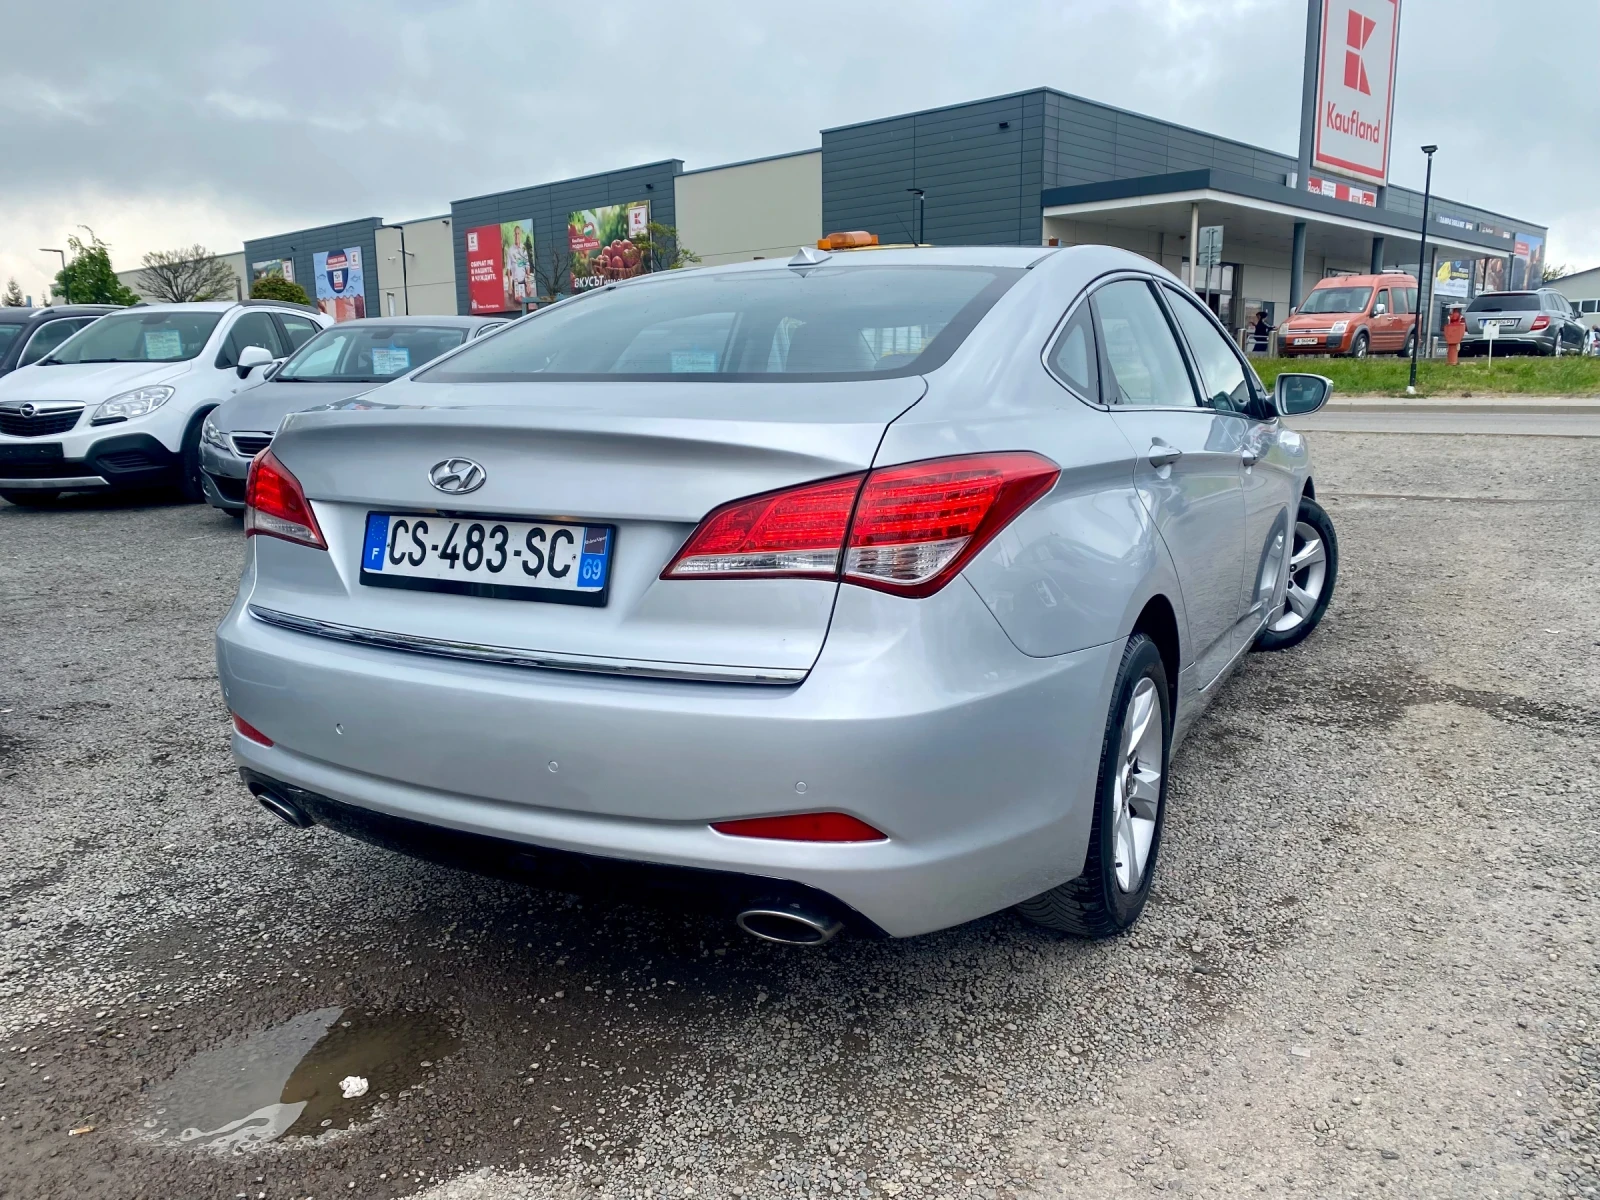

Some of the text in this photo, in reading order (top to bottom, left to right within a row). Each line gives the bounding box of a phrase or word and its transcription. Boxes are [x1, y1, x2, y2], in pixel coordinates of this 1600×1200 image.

[1326, 101, 1381, 144] Kaufland
[470, 259, 487, 268] ОБИЧАТ
[574, 275, 604, 288] ВКУСЪТ
[371, 547, 380, 561] F
[389, 519, 575, 579] CS-483-SC
[582, 558, 602, 580] 69
